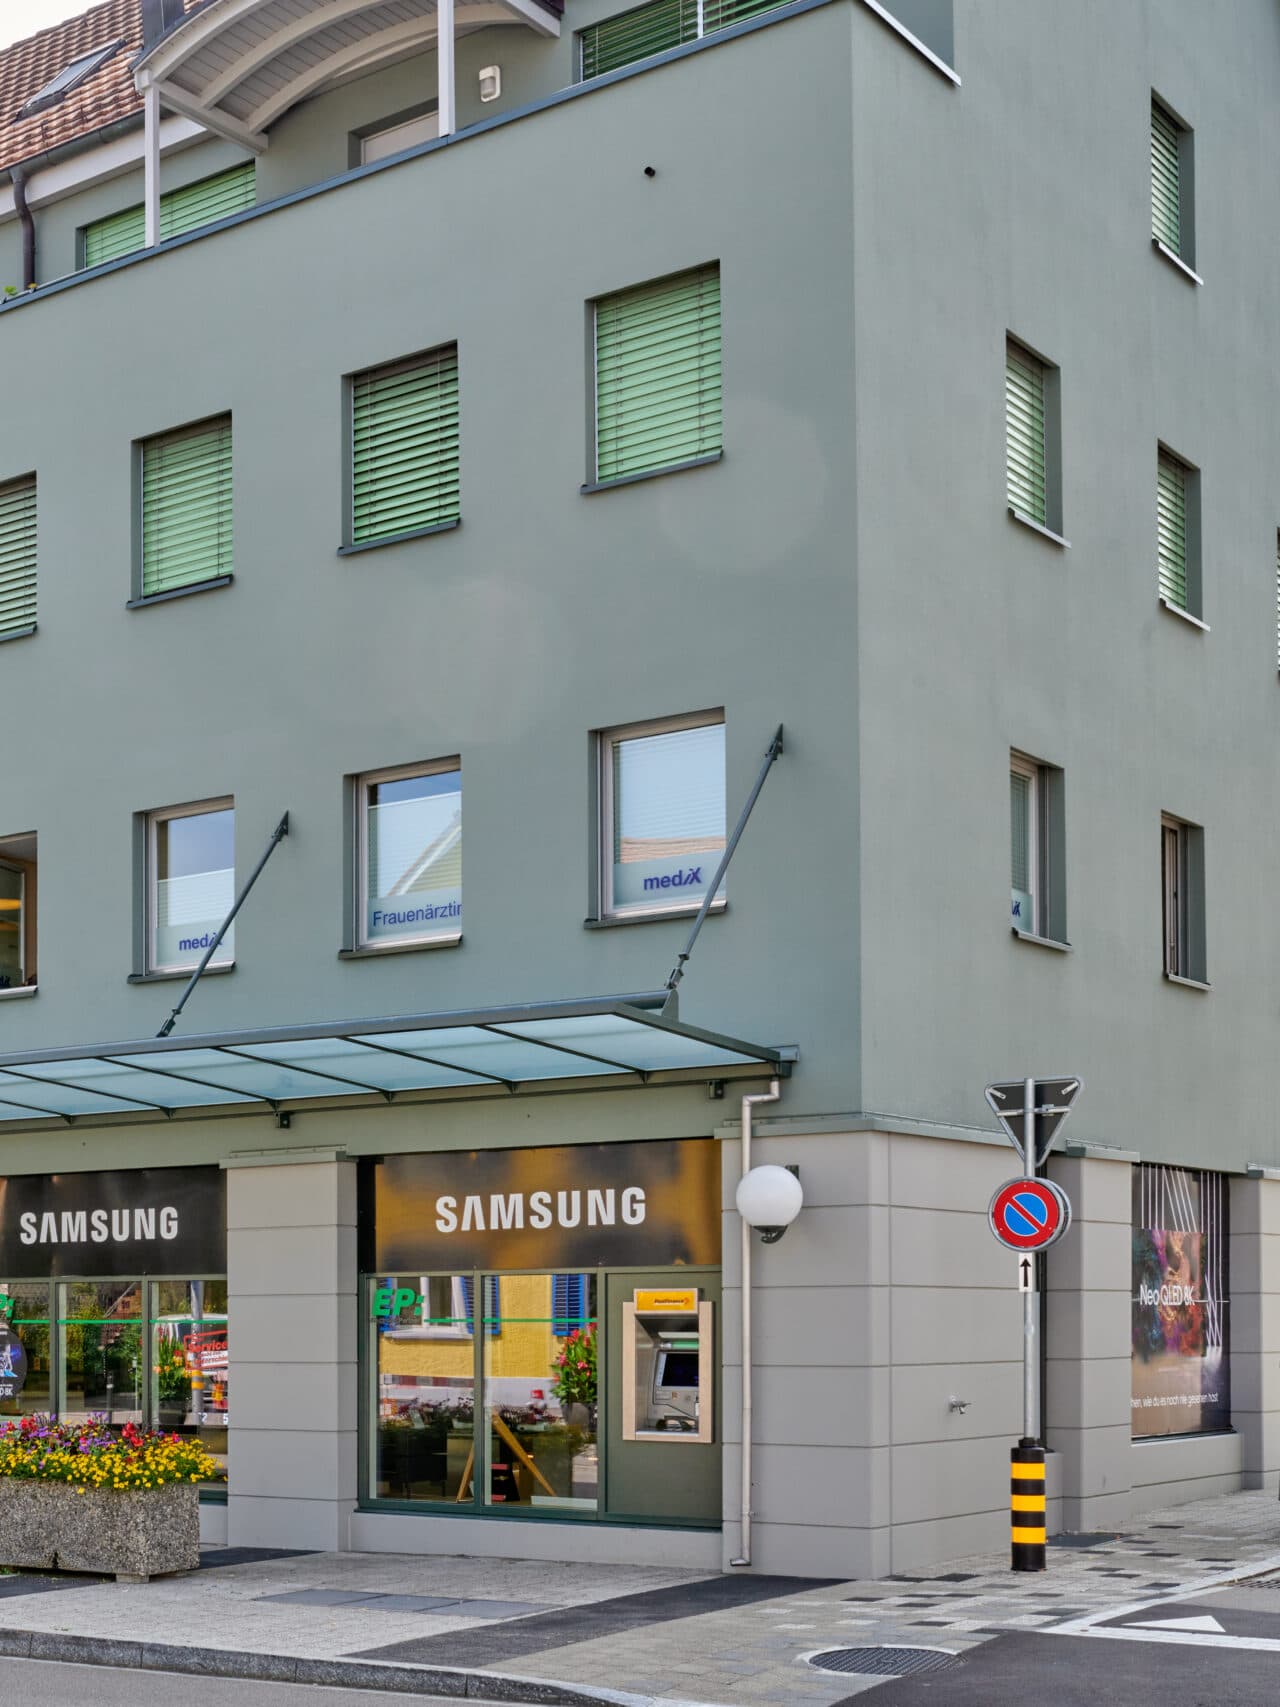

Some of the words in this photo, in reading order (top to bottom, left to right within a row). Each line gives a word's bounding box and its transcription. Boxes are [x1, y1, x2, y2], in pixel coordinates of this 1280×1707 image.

[20, 1206, 178, 1245] SAMSUNG
[435, 1187, 646, 1233] SAMSUNG
[372, 1288, 424, 1317] EP:
[1140, 1283, 1159, 1306] Neo
[1161, 1284, 1183, 1306] QLED
